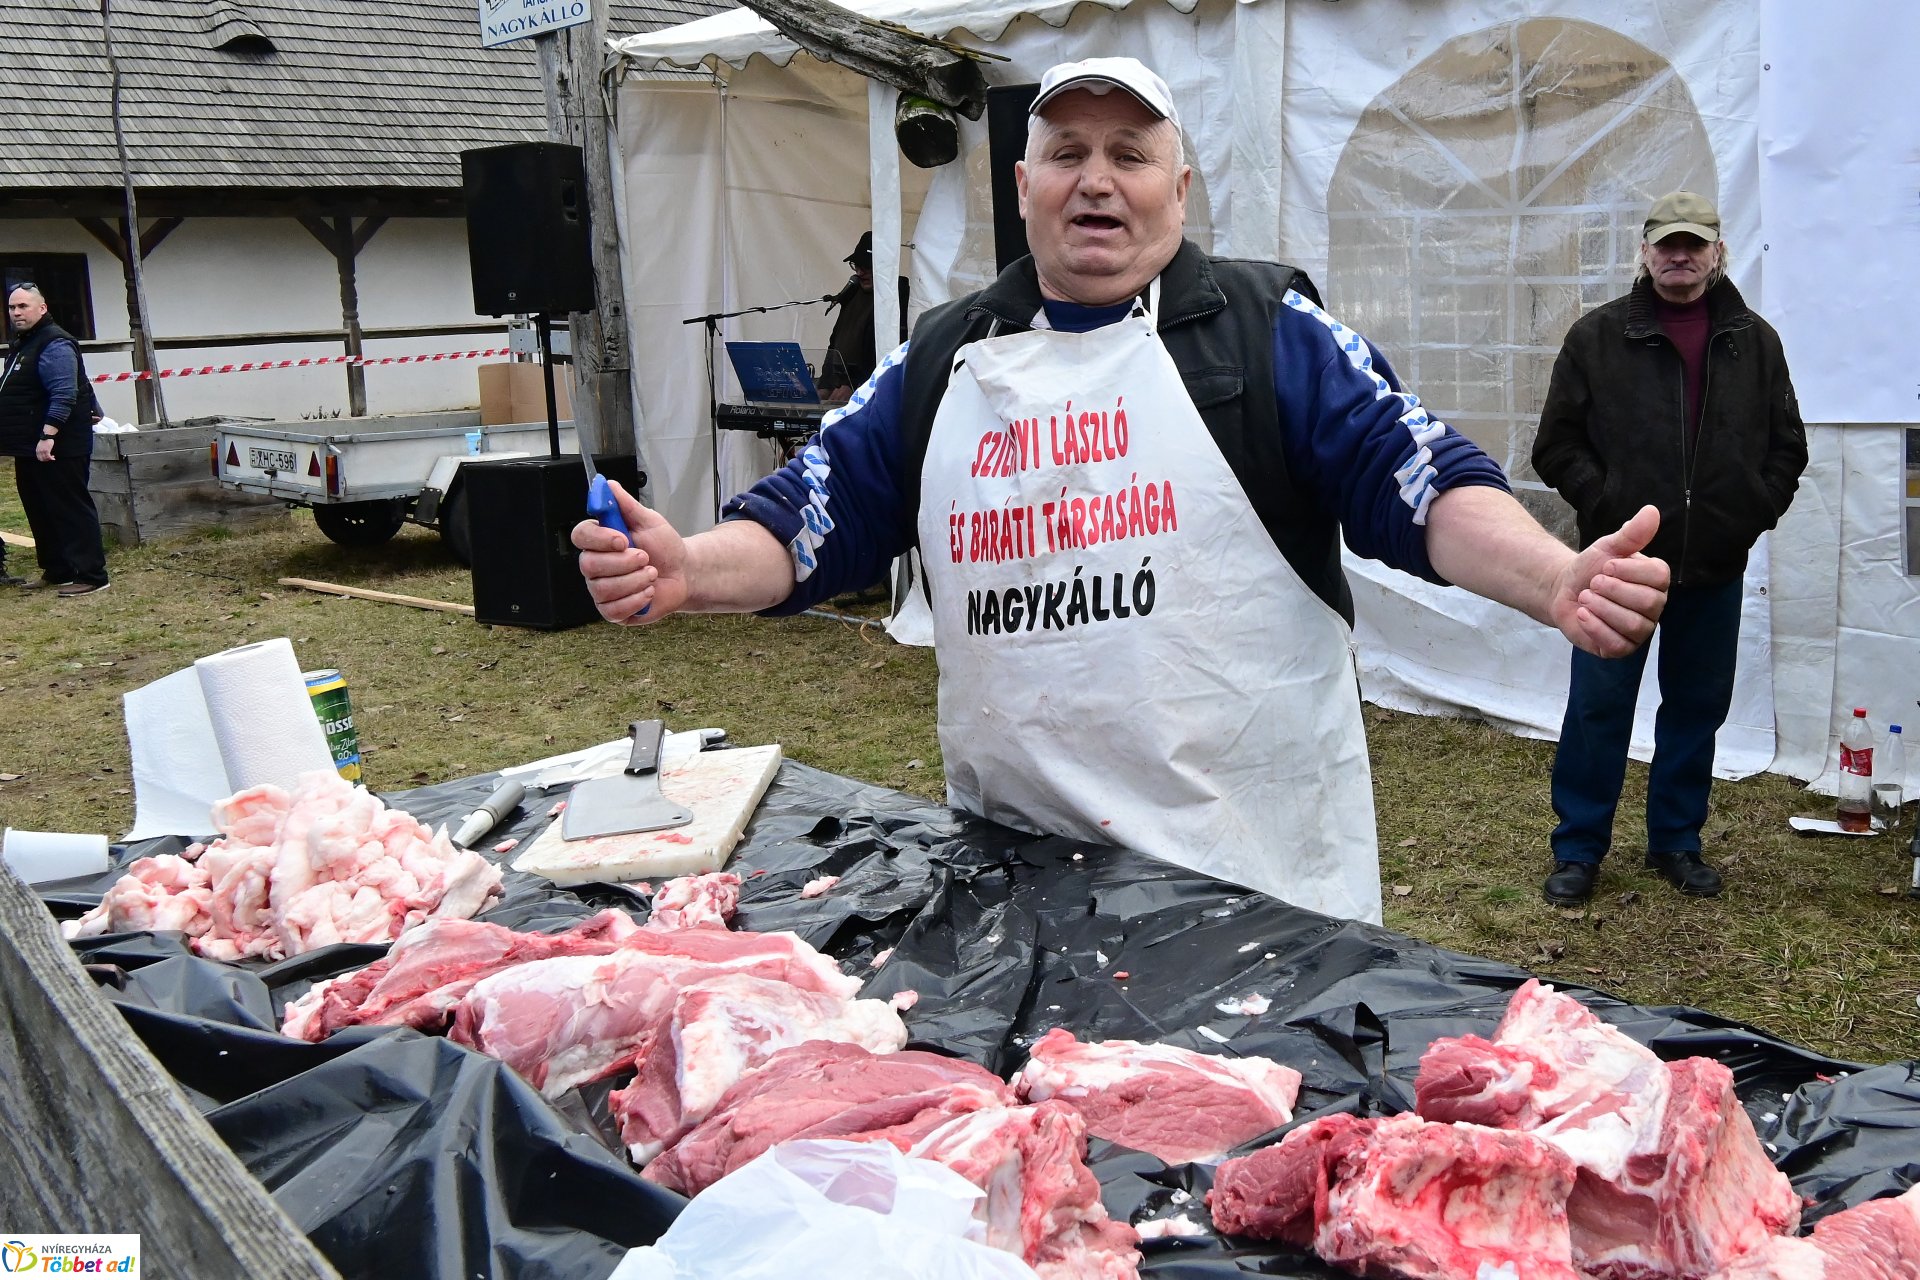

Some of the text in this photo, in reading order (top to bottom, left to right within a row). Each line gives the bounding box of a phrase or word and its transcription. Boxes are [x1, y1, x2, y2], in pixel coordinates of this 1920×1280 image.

[487, 0, 584, 38] NAGYKÁLLÓ
[730, 406, 756, 415] Roland
[1050, 396, 1129, 466] LÁSZLÓ
[949, 472, 1178, 565] ÉS BARÁTI TÁRSASÁGA
[967, 556, 1156, 636] NAGYKÁLLÓ
